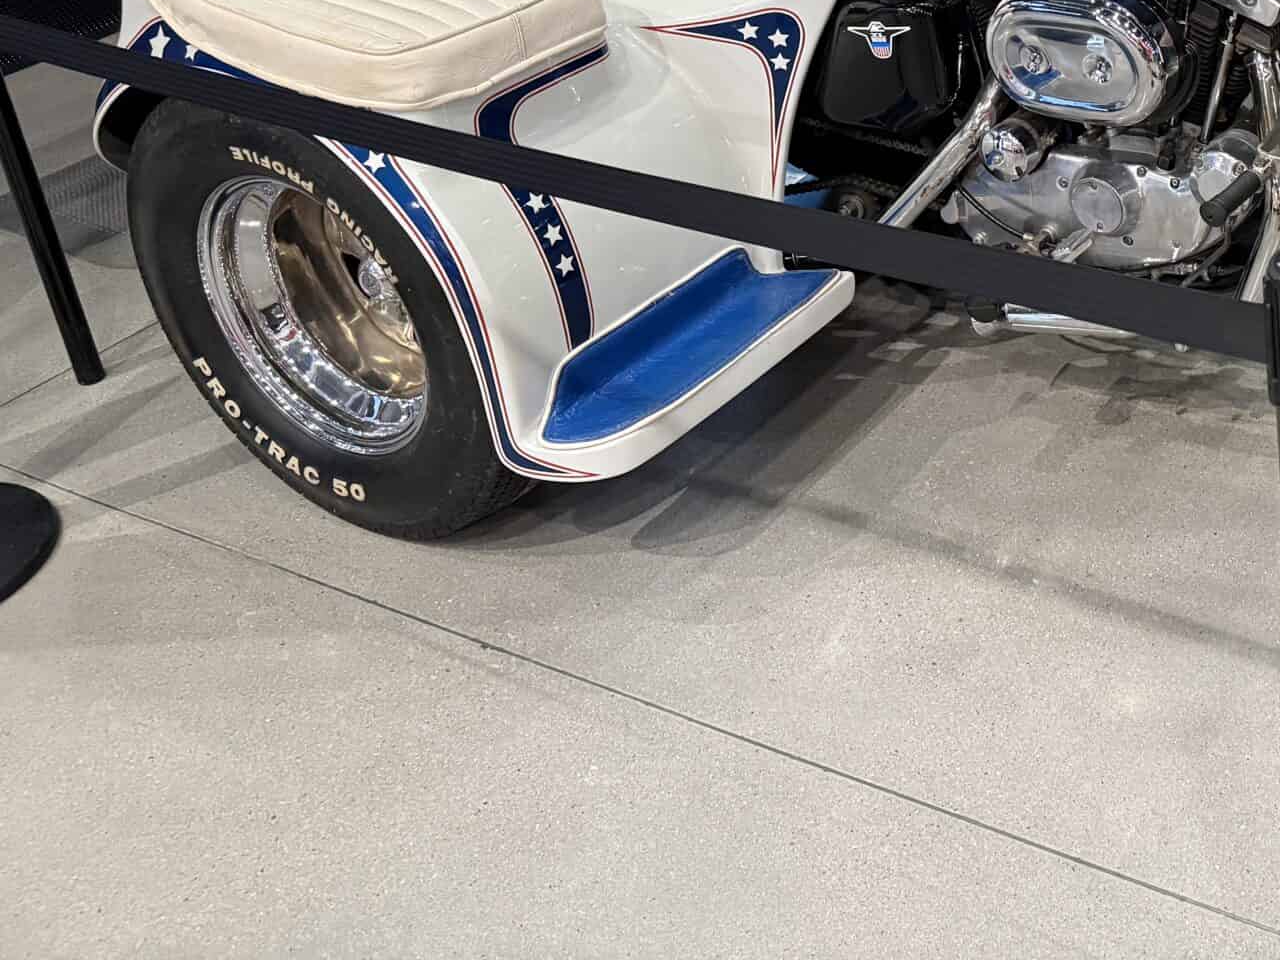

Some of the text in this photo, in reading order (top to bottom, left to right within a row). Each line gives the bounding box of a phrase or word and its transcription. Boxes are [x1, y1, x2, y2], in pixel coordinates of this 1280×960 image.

[228, 145, 315, 193] PROFILE
[192, 356, 367, 502] PRO-TRAC 50
